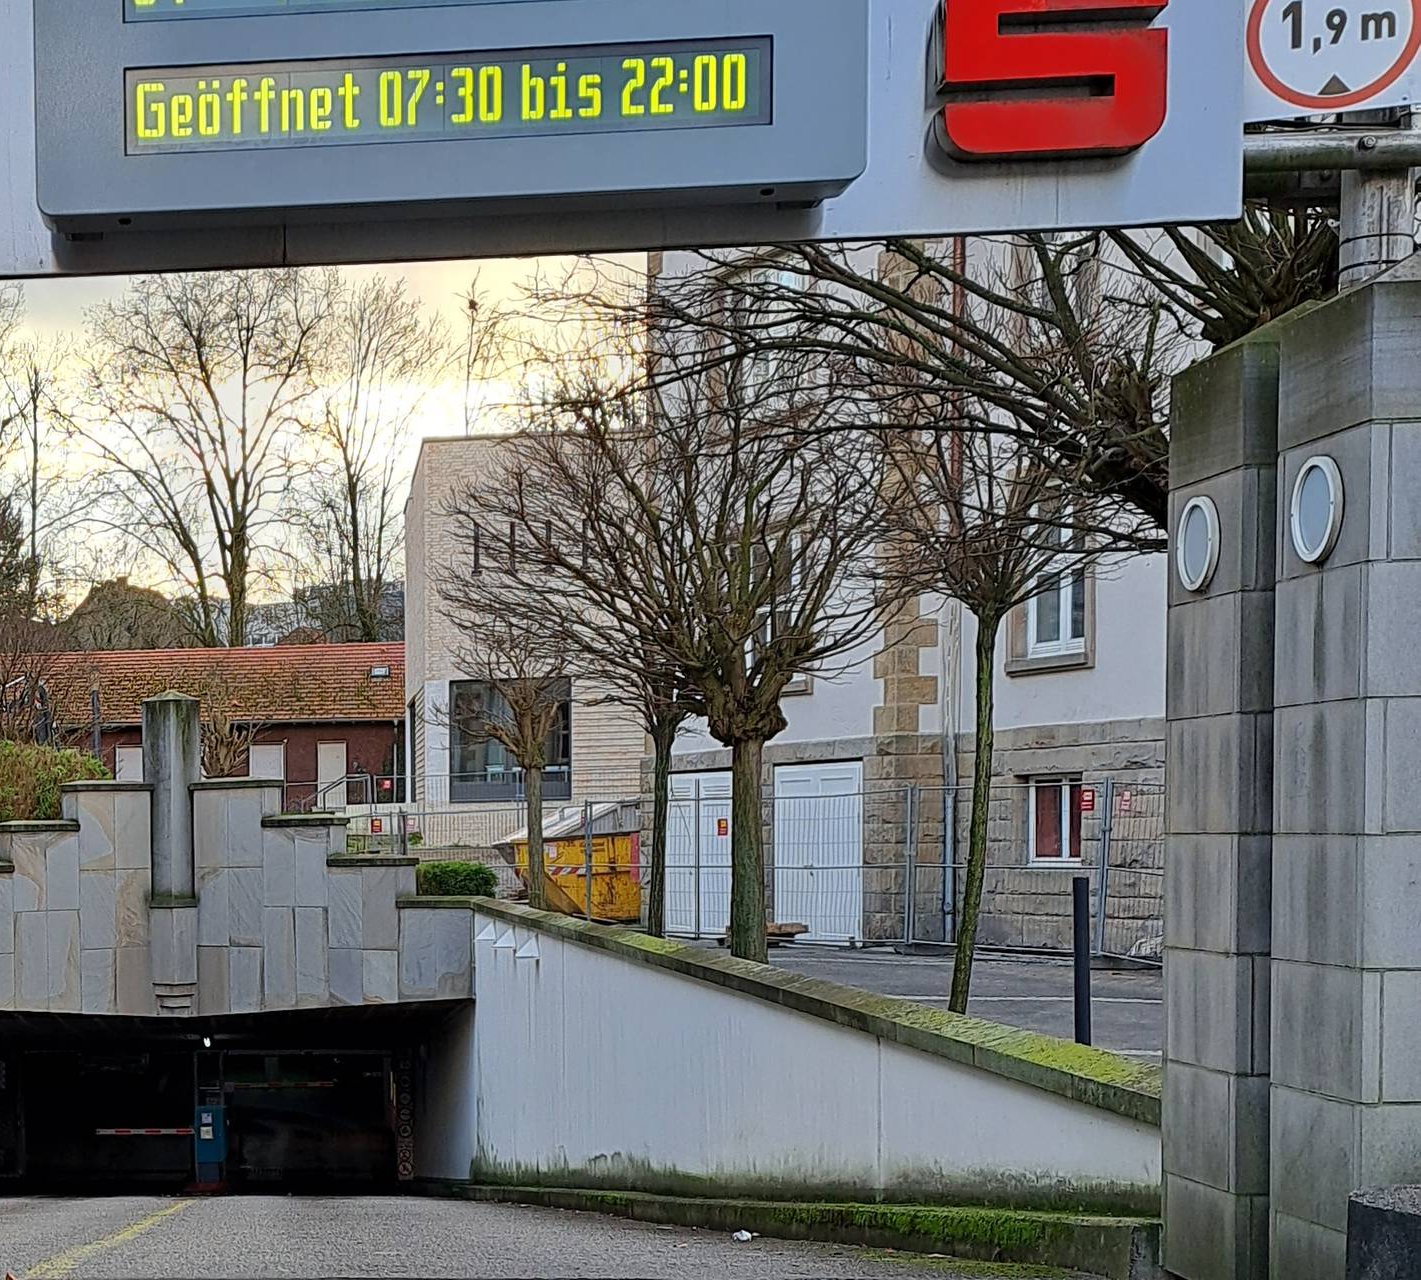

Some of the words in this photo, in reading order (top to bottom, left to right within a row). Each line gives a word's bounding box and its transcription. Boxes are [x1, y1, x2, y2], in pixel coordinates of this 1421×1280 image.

[1281, 0, 1348, 55] 1,9
[1360, 11, 1397, 42] m
[134, 72, 361, 141] Geöffnet
[378, 66, 504, 128] 07:30
[520, 62, 603, 121] bis
[620, 53, 747, 118] 22:00
